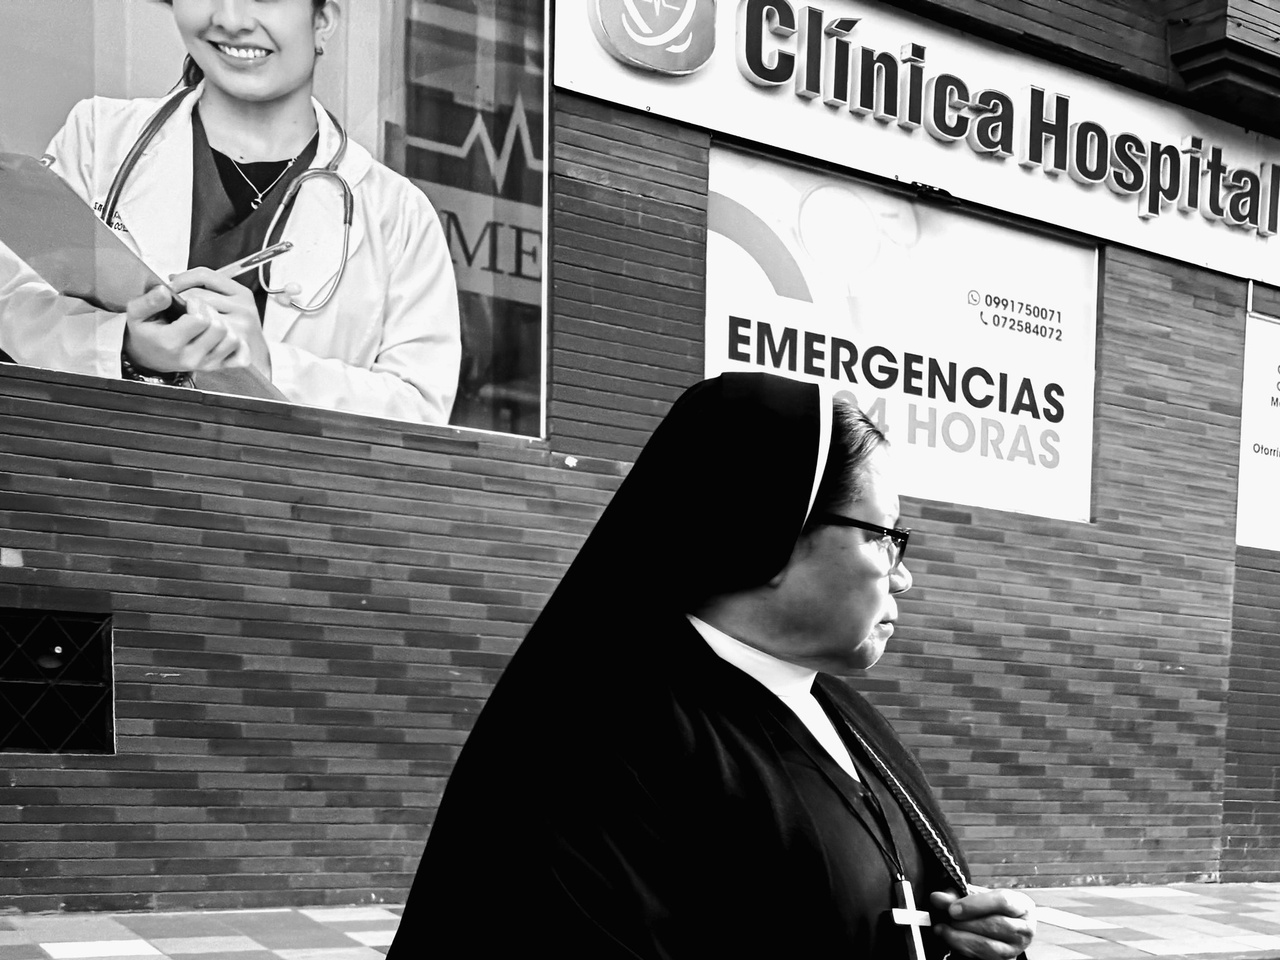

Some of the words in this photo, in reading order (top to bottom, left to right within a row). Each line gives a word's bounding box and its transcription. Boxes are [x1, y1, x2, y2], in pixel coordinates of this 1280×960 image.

[738, 0, 1015, 158] Clínica
[985, 294, 1062, 323] 0991750071
[993, 314, 1063, 342] 072584072
[728, 315, 1065, 423] EMERGENCIAS
[907, 403, 1061, 469] HORAS
